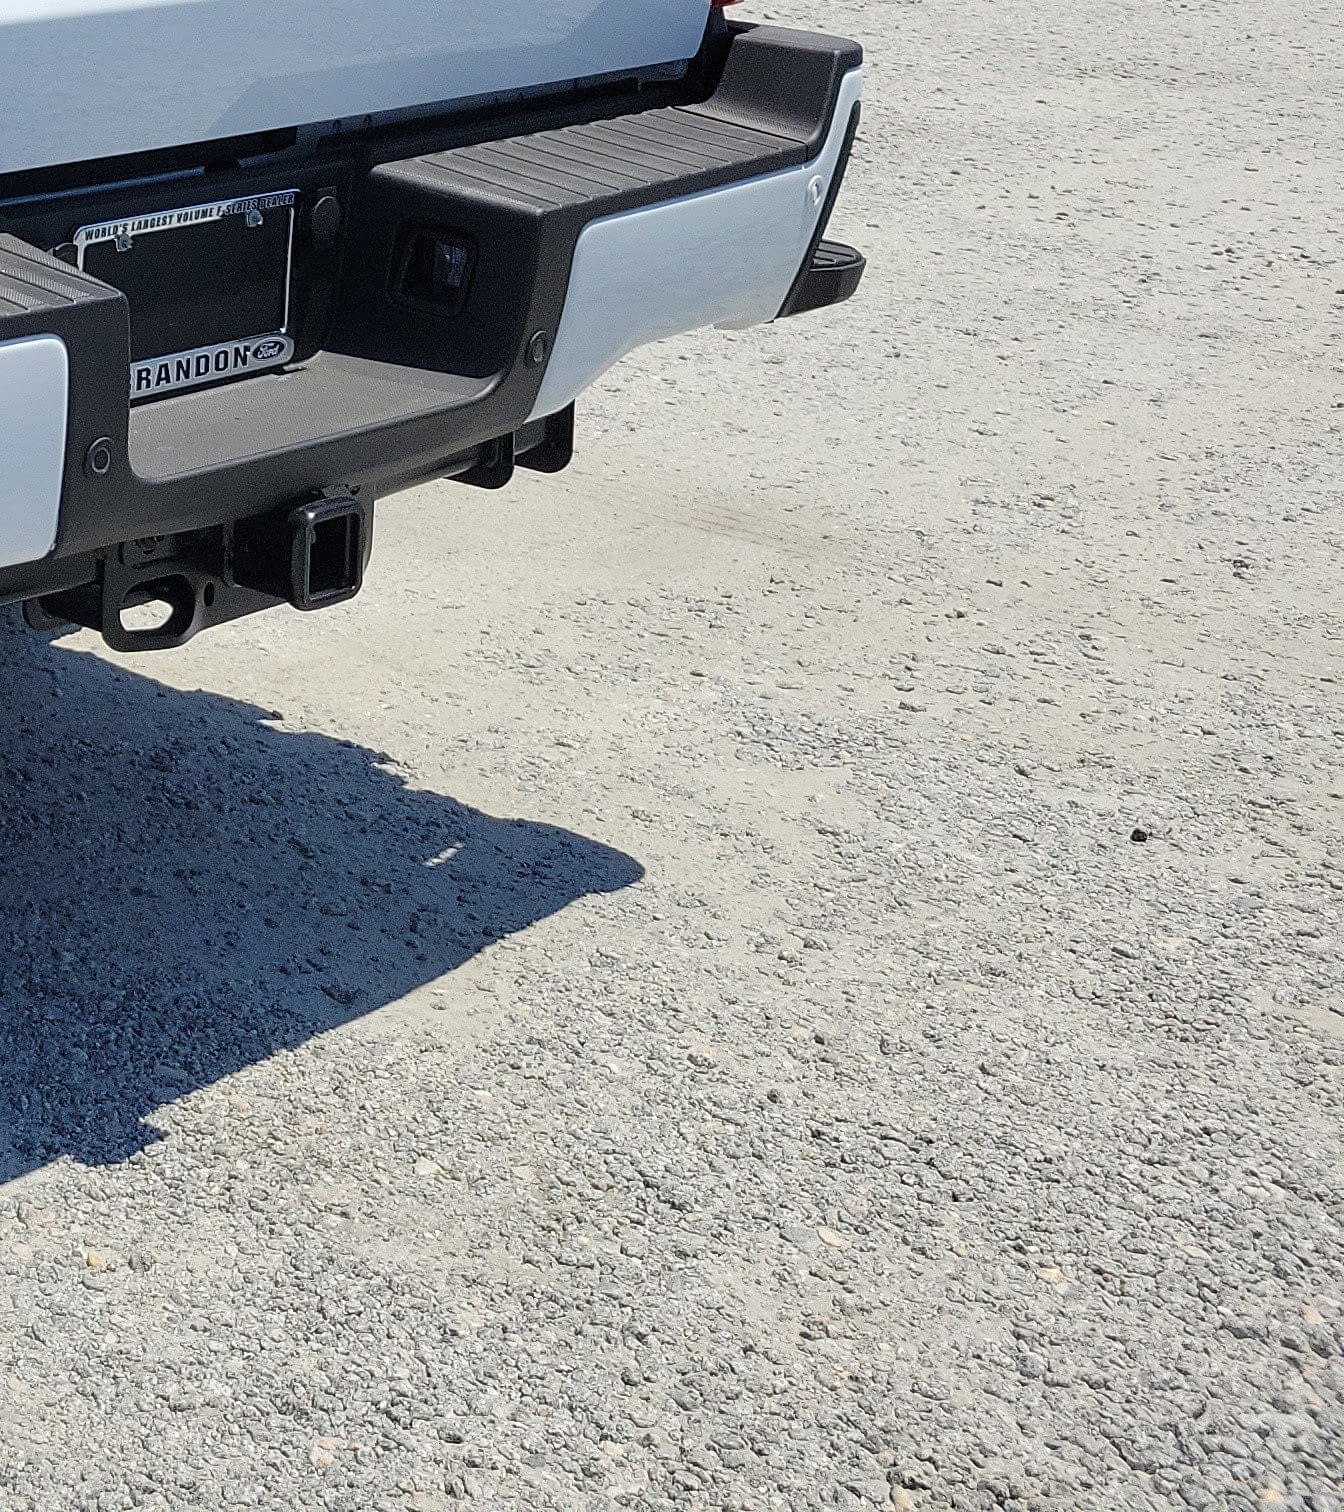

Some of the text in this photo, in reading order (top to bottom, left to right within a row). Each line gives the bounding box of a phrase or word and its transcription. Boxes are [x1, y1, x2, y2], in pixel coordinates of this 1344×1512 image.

[85, 223, 129, 241] WORLD'S
[130, 214, 175, 232] LARGEST
[176, 207, 215, 224] VOLUME
[259, 192, 295, 209] DEALER
[130, 341, 281, 391] RANDON Ford
